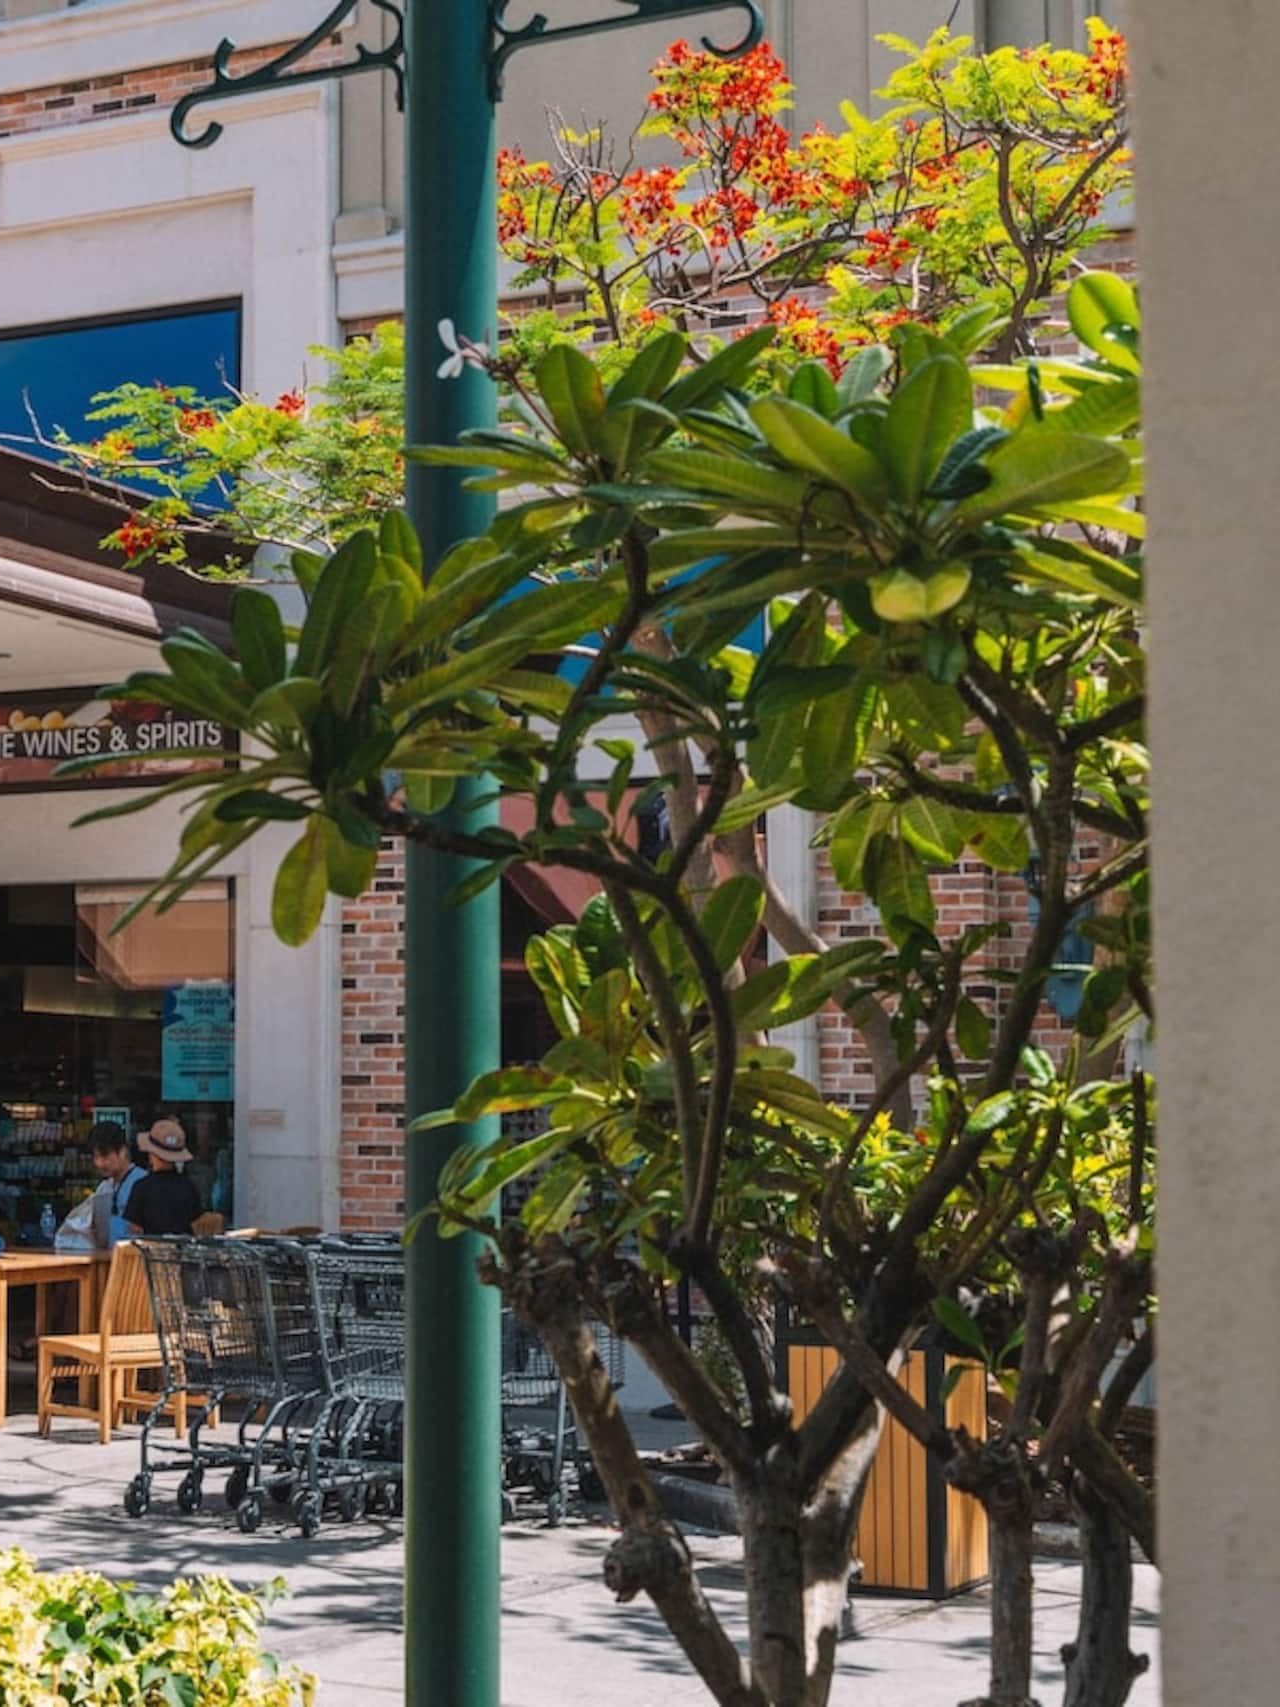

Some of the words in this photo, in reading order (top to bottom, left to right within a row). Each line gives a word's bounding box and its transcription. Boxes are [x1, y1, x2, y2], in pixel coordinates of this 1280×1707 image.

[23, 726, 100, 756] WINES
[110, 726, 129, 751] &
[136, 719, 222, 750] SPIRITS
